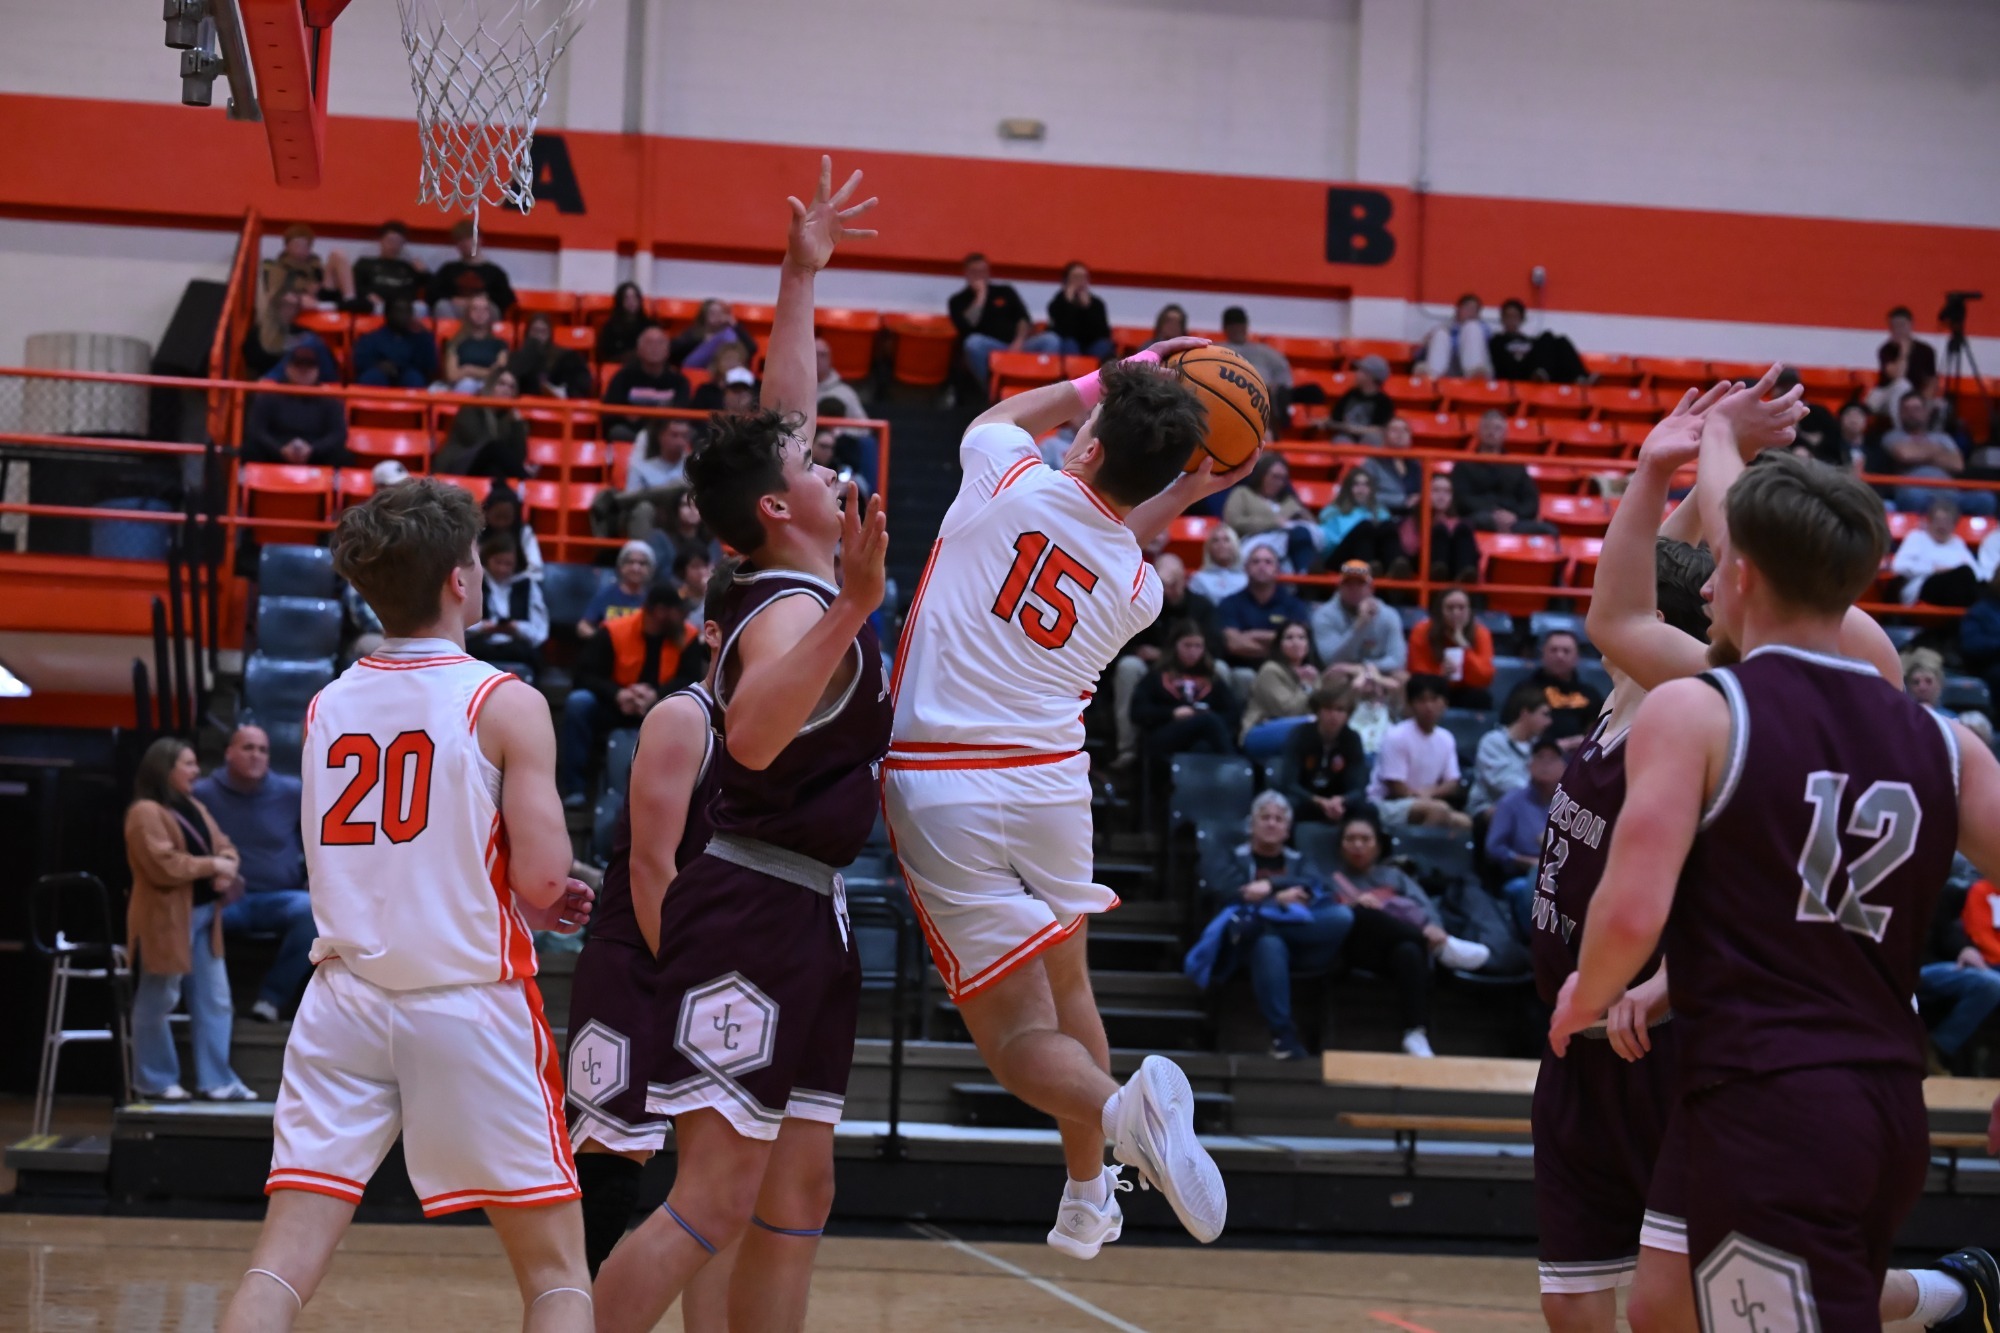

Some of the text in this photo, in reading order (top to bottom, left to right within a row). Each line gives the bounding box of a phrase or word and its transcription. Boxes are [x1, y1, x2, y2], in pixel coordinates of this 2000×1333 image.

[502, 134, 586, 214] A
[1326, 187, 1396, 266] B
[990, 530, 1099, 651] 15
[320, 729, 435, 846] 20
[1796, 770, 1922, 943] 12
[582, 1046, 602, 1086] JC
[712, 1003, 742, 1051] JC
